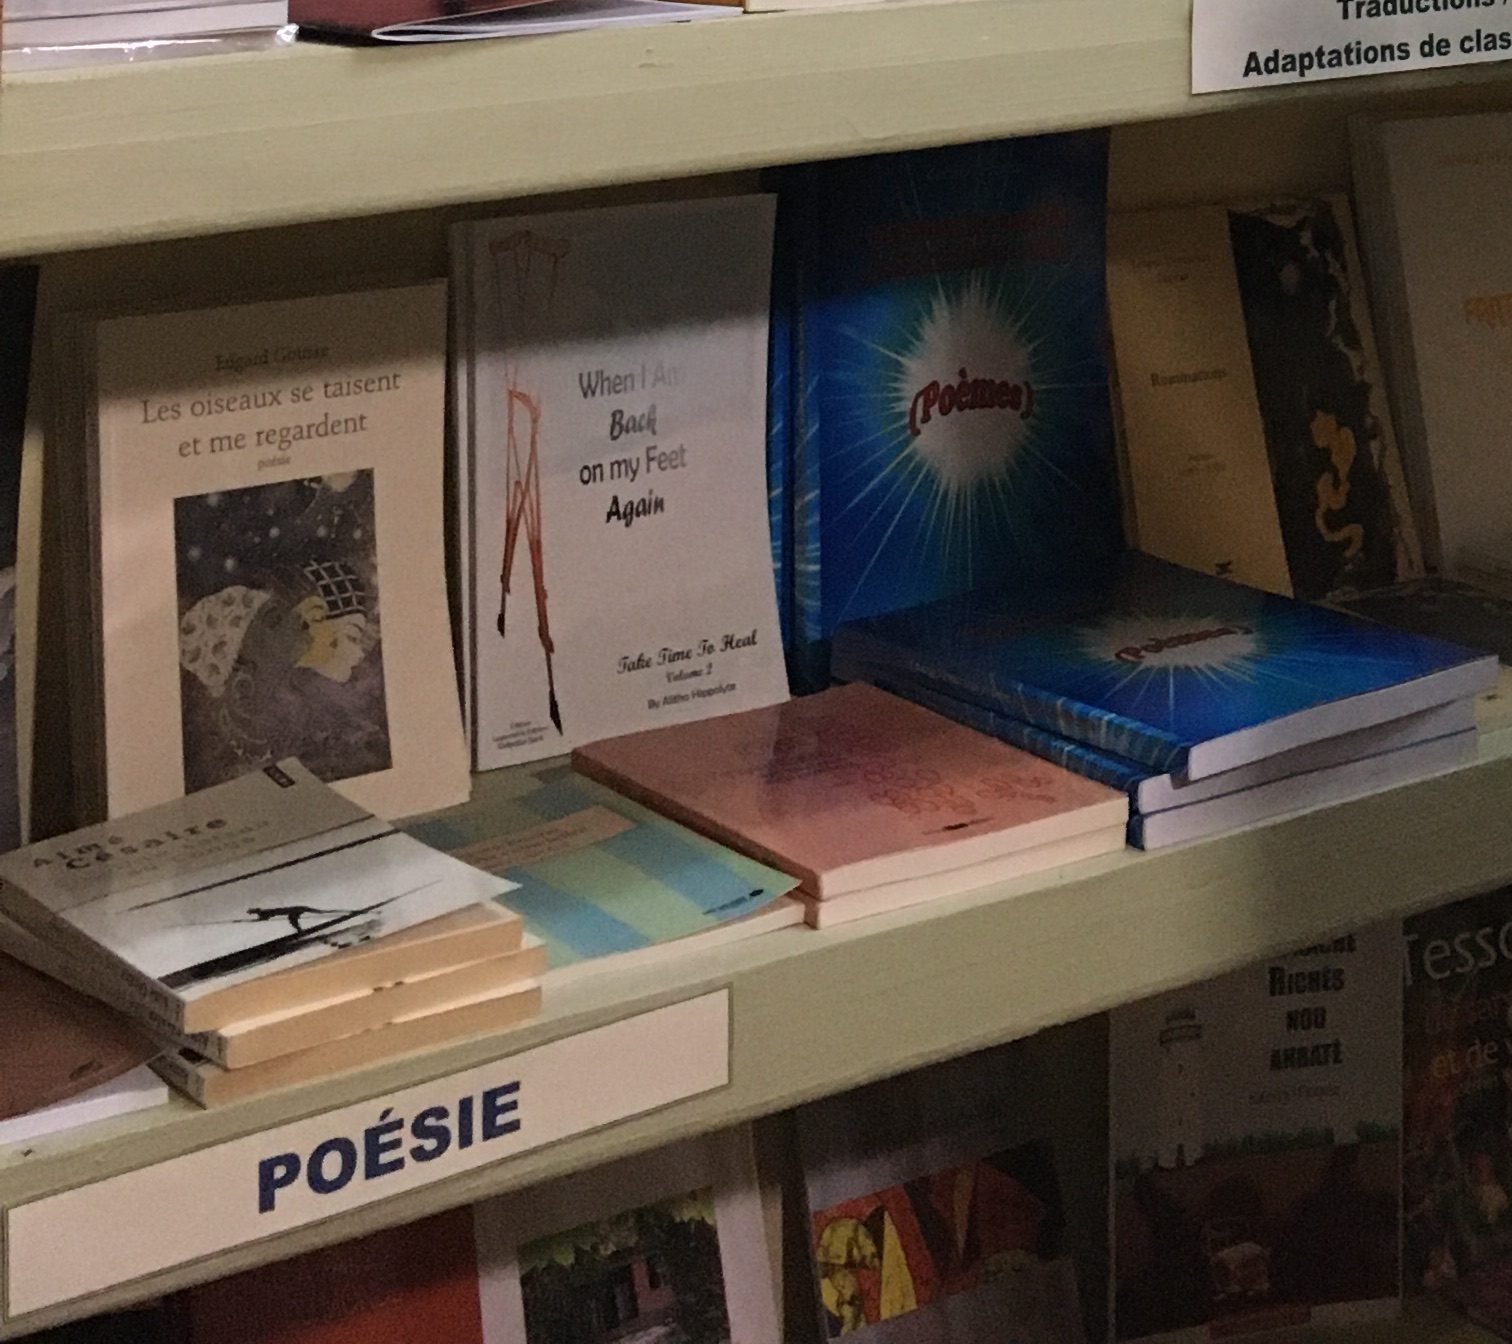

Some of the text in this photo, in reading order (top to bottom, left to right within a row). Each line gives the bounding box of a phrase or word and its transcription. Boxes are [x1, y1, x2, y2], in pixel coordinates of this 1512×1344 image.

[1242, 38, 1411, 79] Adaptations
[1420, 33, 1452, 58] de
[141, 372, 402, 425] Les oiseaux se taisent
[578, 369, 635, 400] When
[178, 411, 369, 459] et me regardent
[609, 403, 657, 442] Back
[579, 443, 688, 486] on my Feet
[605, 489, 665, 528] Again
[616, 628, 758, 675] Take Time To Heal
[257, 1080, 522, 1214] POÉSIE
